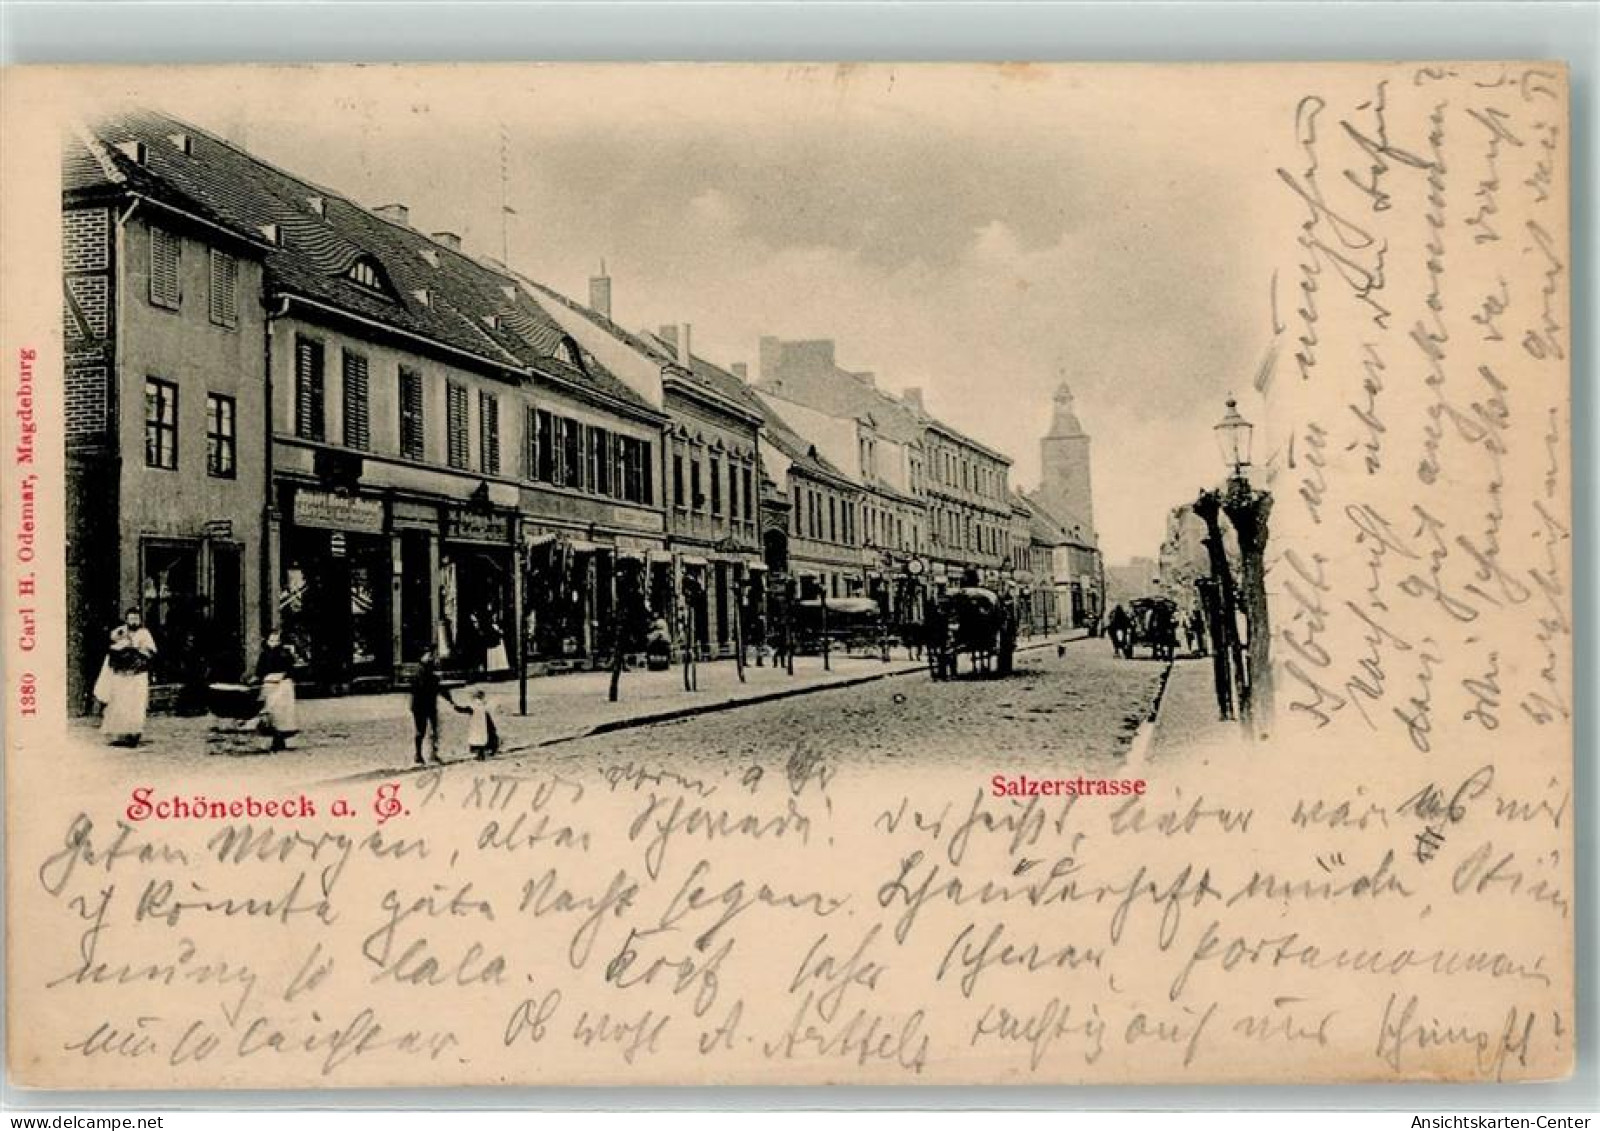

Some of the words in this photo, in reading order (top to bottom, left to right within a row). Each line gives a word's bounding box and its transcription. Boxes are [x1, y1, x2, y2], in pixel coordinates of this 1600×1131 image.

[16, 347, 37, 465] Magdeburg
[19, 571, 36, 597] H.
[18, 607, 36, 653] Carl
[20, 672, 37, 717] 1380
[126, 787, 317, 821] Schönebeck
[330, 799, 357, 818] a.
[991, 775, 1148, 798] Salzerstrasse
